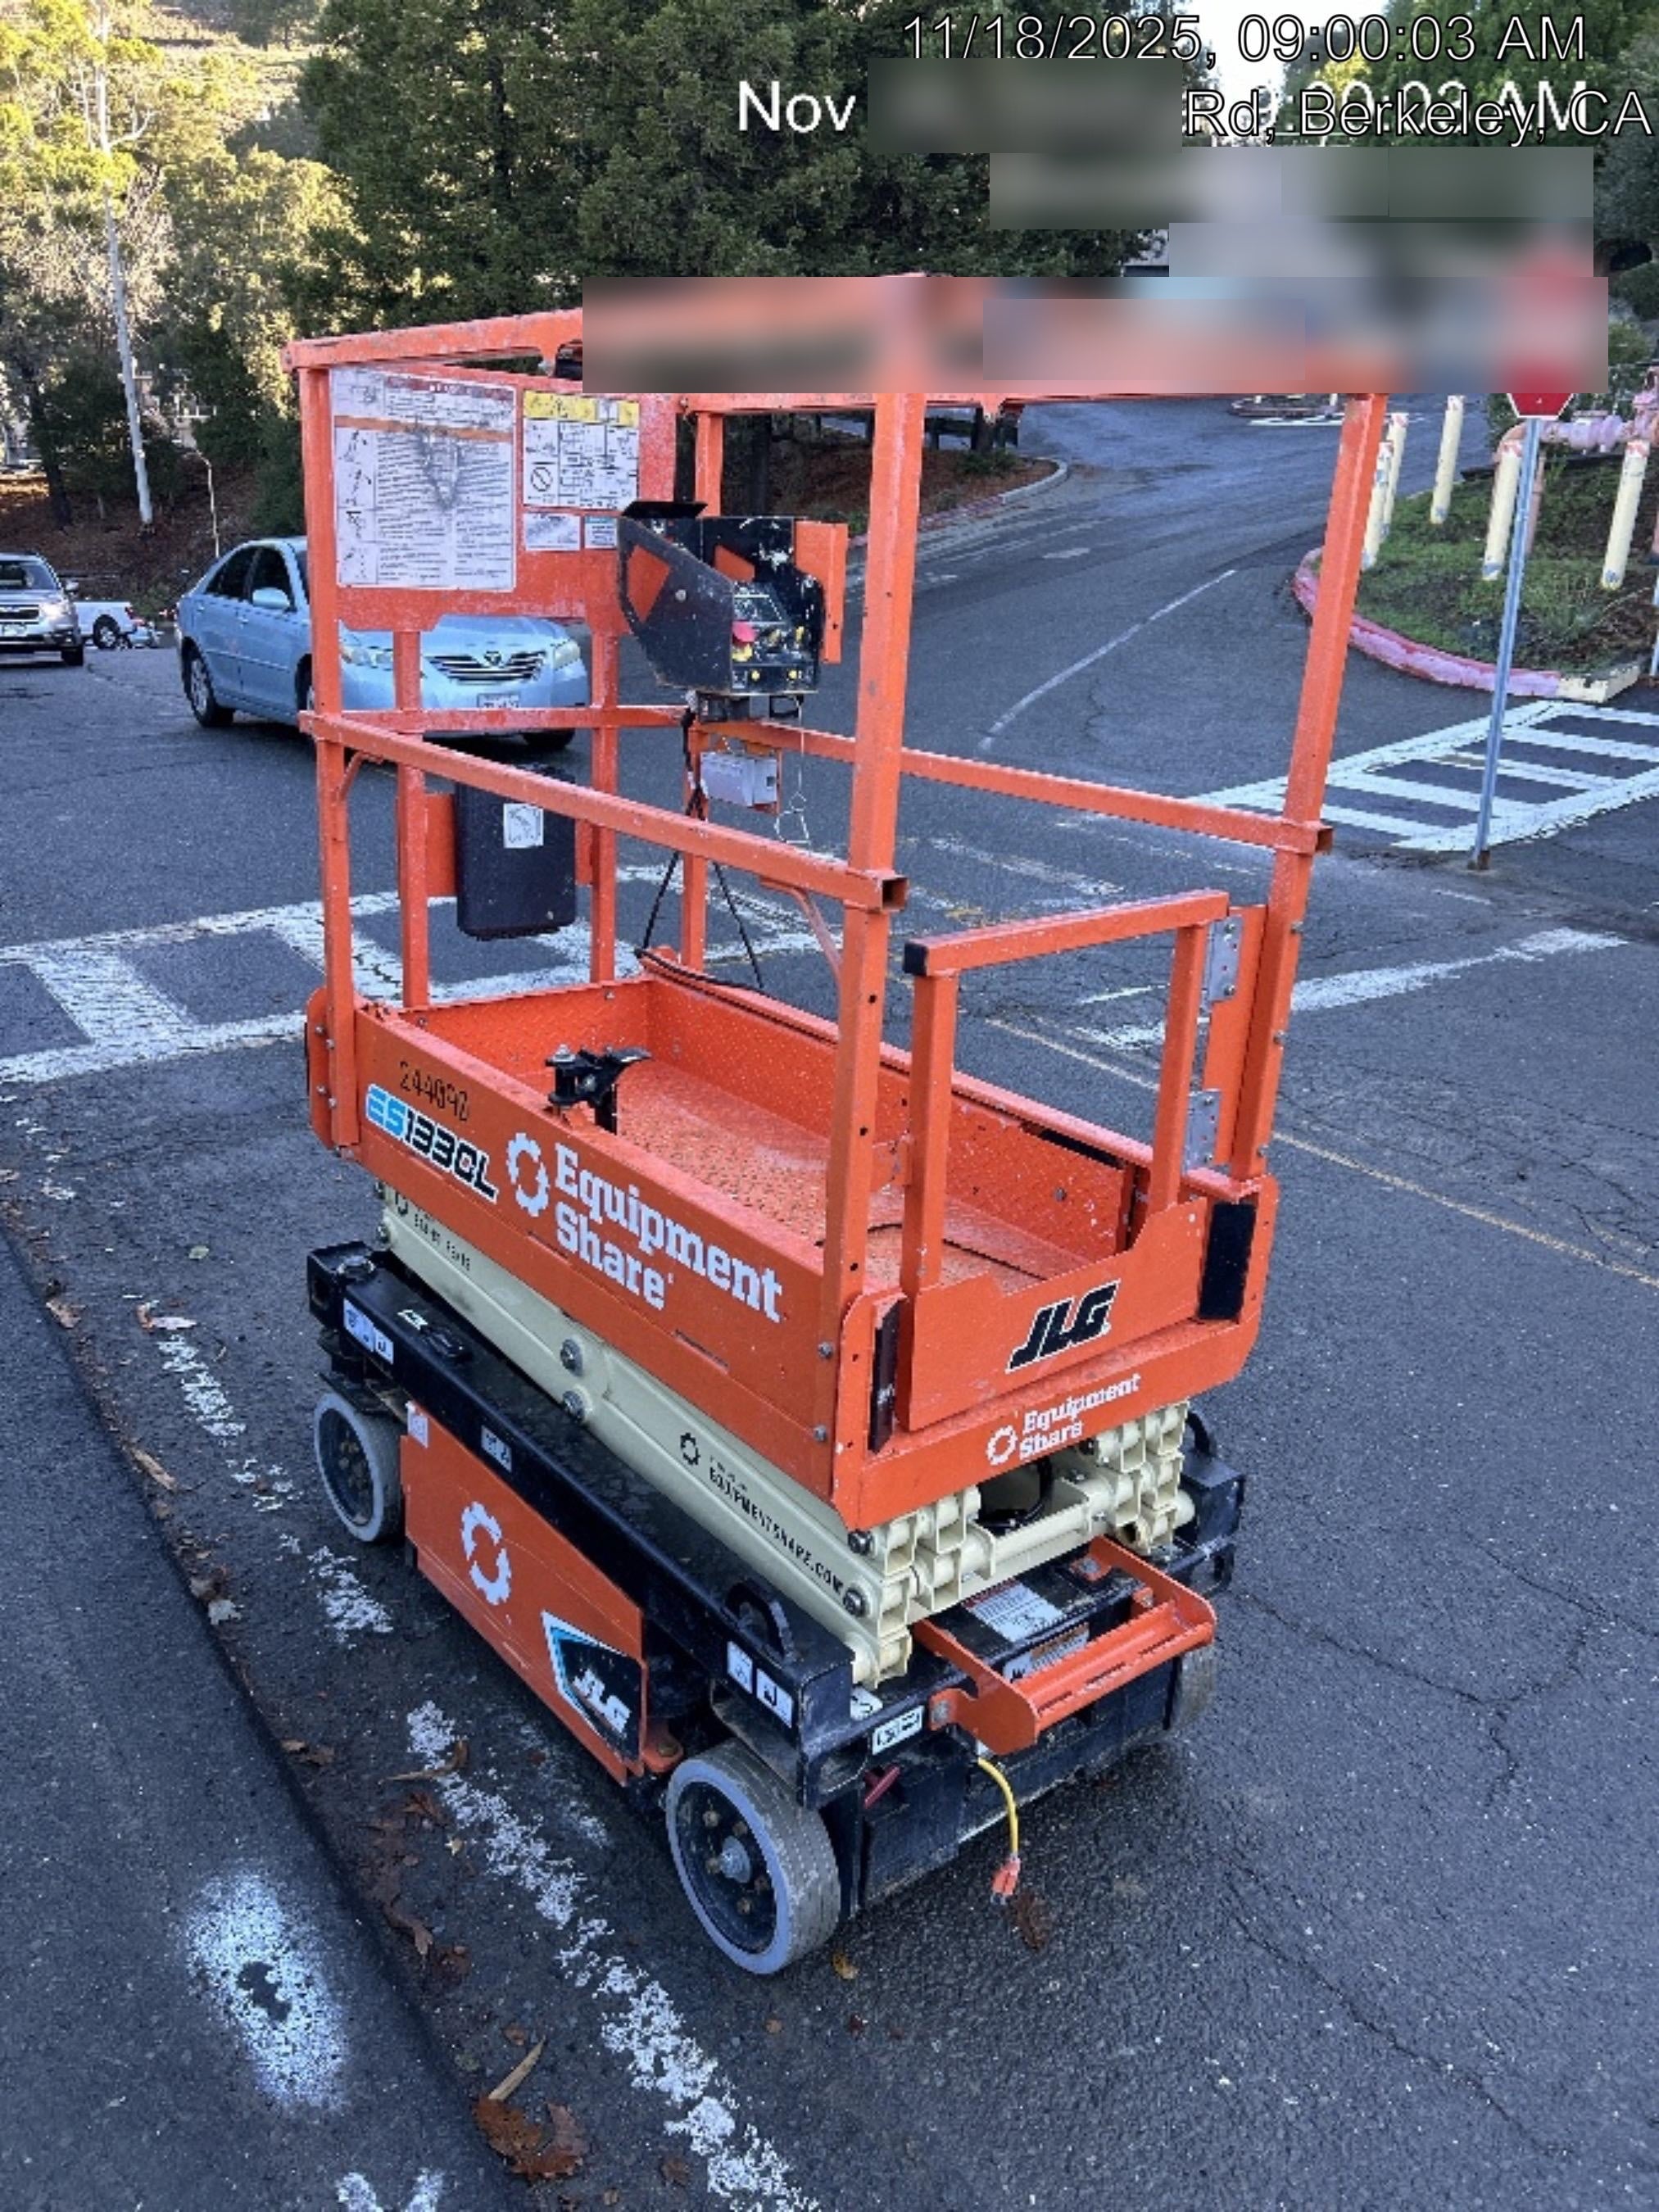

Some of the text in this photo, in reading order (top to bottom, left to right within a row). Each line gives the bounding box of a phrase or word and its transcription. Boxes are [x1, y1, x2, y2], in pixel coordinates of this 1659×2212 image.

[555, 1142, 783, 1324] Equipment
[555, 1201, 665, 1311] Share
[1005, 1278, 1121, 1374] JLG
[1019, 1419, 1084, 1462] Share
[1022, 1373, 1141, 1435] Equipment
